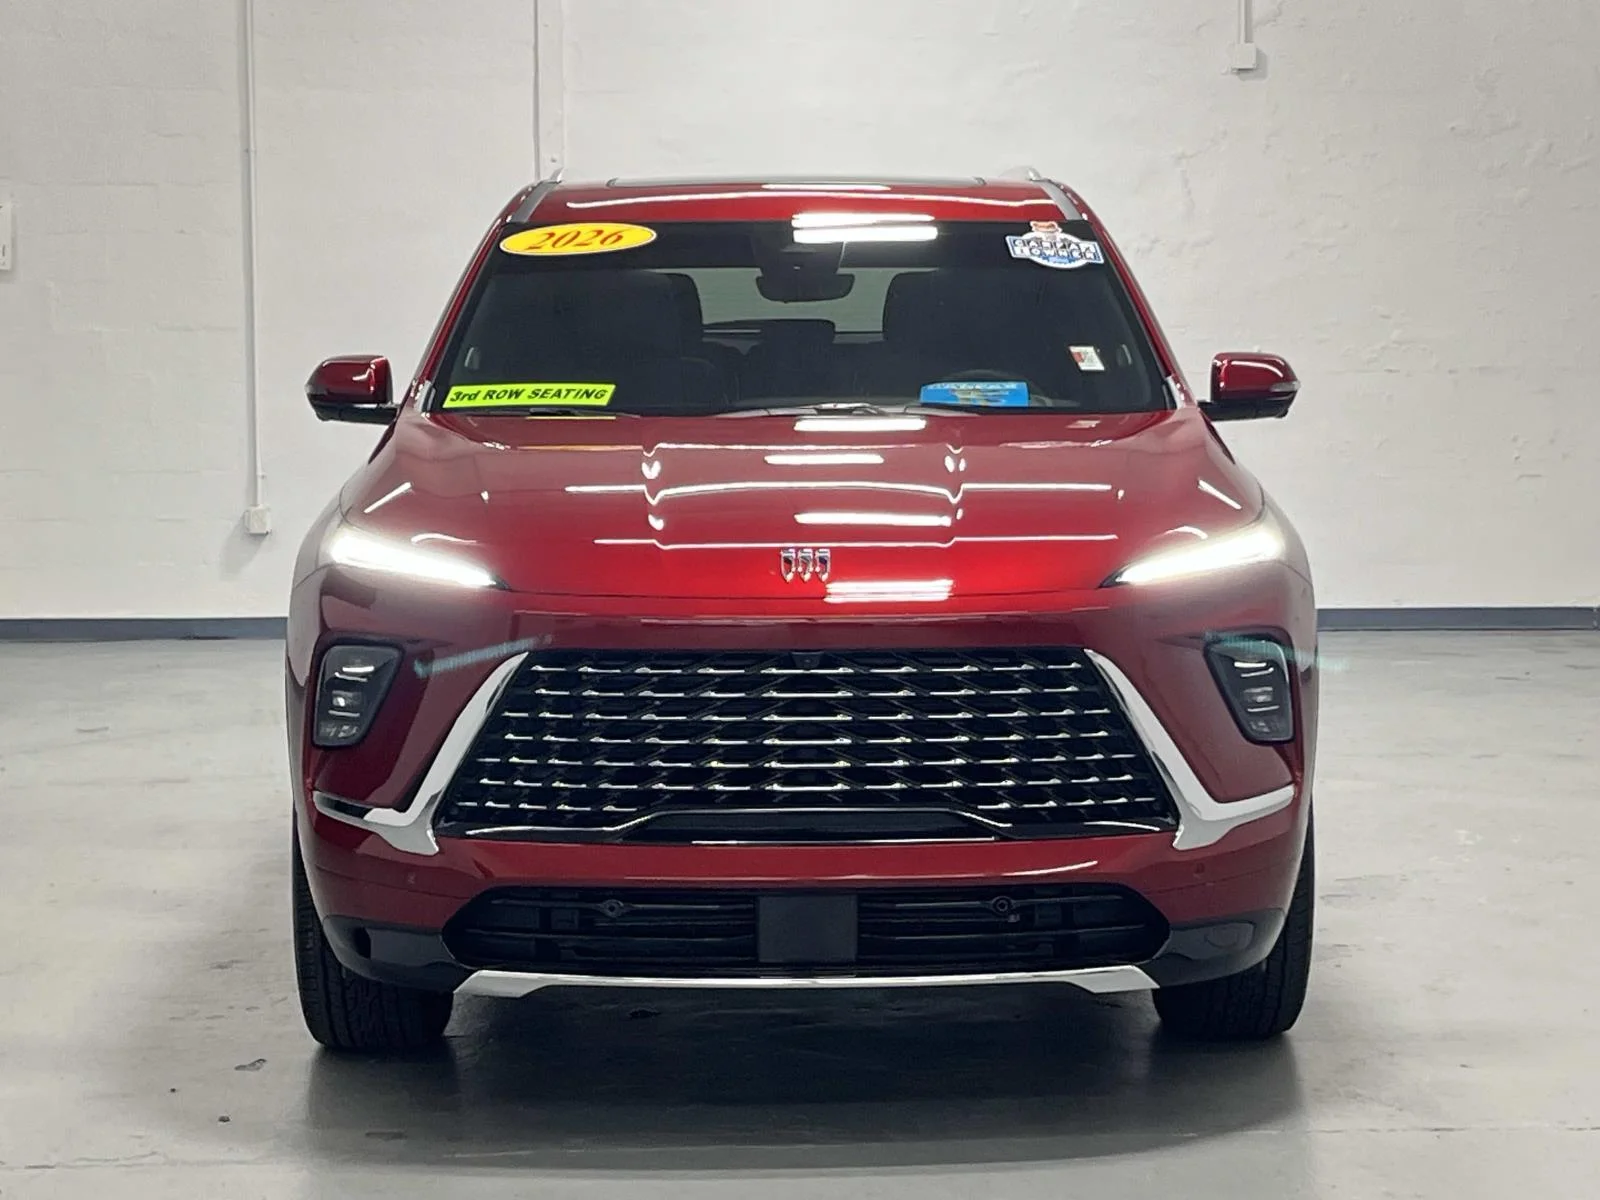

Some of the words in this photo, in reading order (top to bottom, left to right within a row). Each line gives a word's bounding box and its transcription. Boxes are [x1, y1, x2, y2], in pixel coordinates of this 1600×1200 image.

[524, 228, 626, 250] 2026
[450, 390, 480, 402] 3rd
[483, 388, 525, 400] ROW
[528, 388, 608, 400] SEATING
